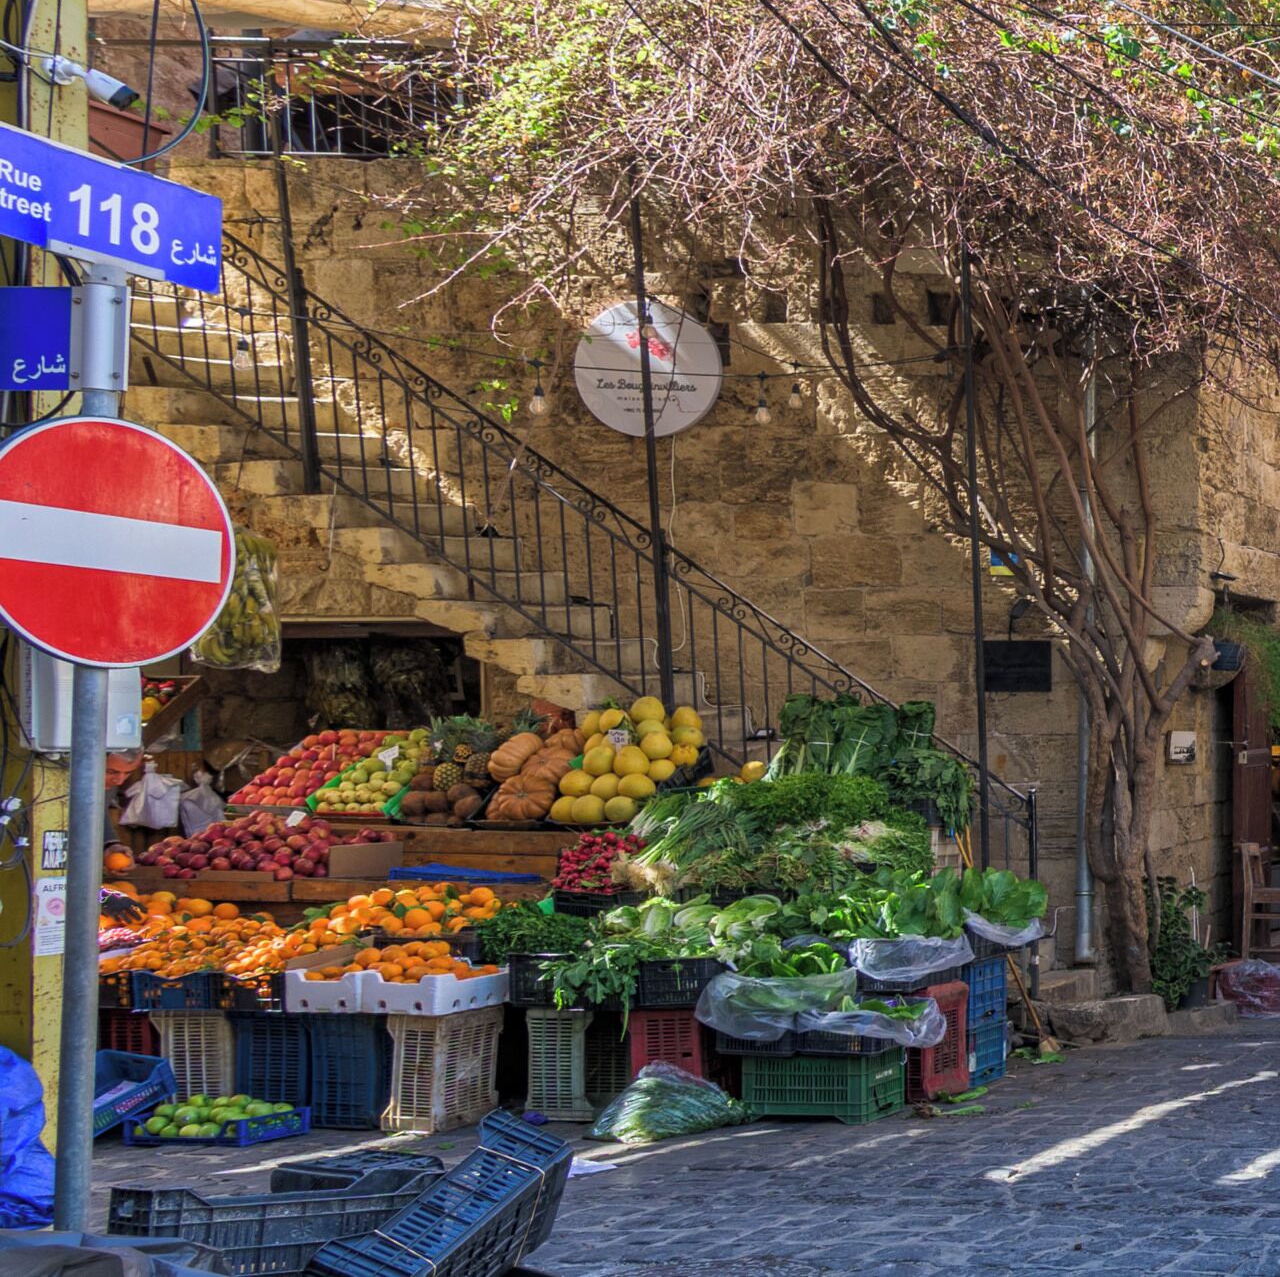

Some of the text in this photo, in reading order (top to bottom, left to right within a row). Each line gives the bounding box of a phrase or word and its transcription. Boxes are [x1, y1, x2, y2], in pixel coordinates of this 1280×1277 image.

[0, 159, 42, 192] Rue
[0, 190, 52, 222] treet
[69, 184, 160, 255] 118
[170, 238, 217, 266] شارع
[12, 354, 66, 383] شارع
